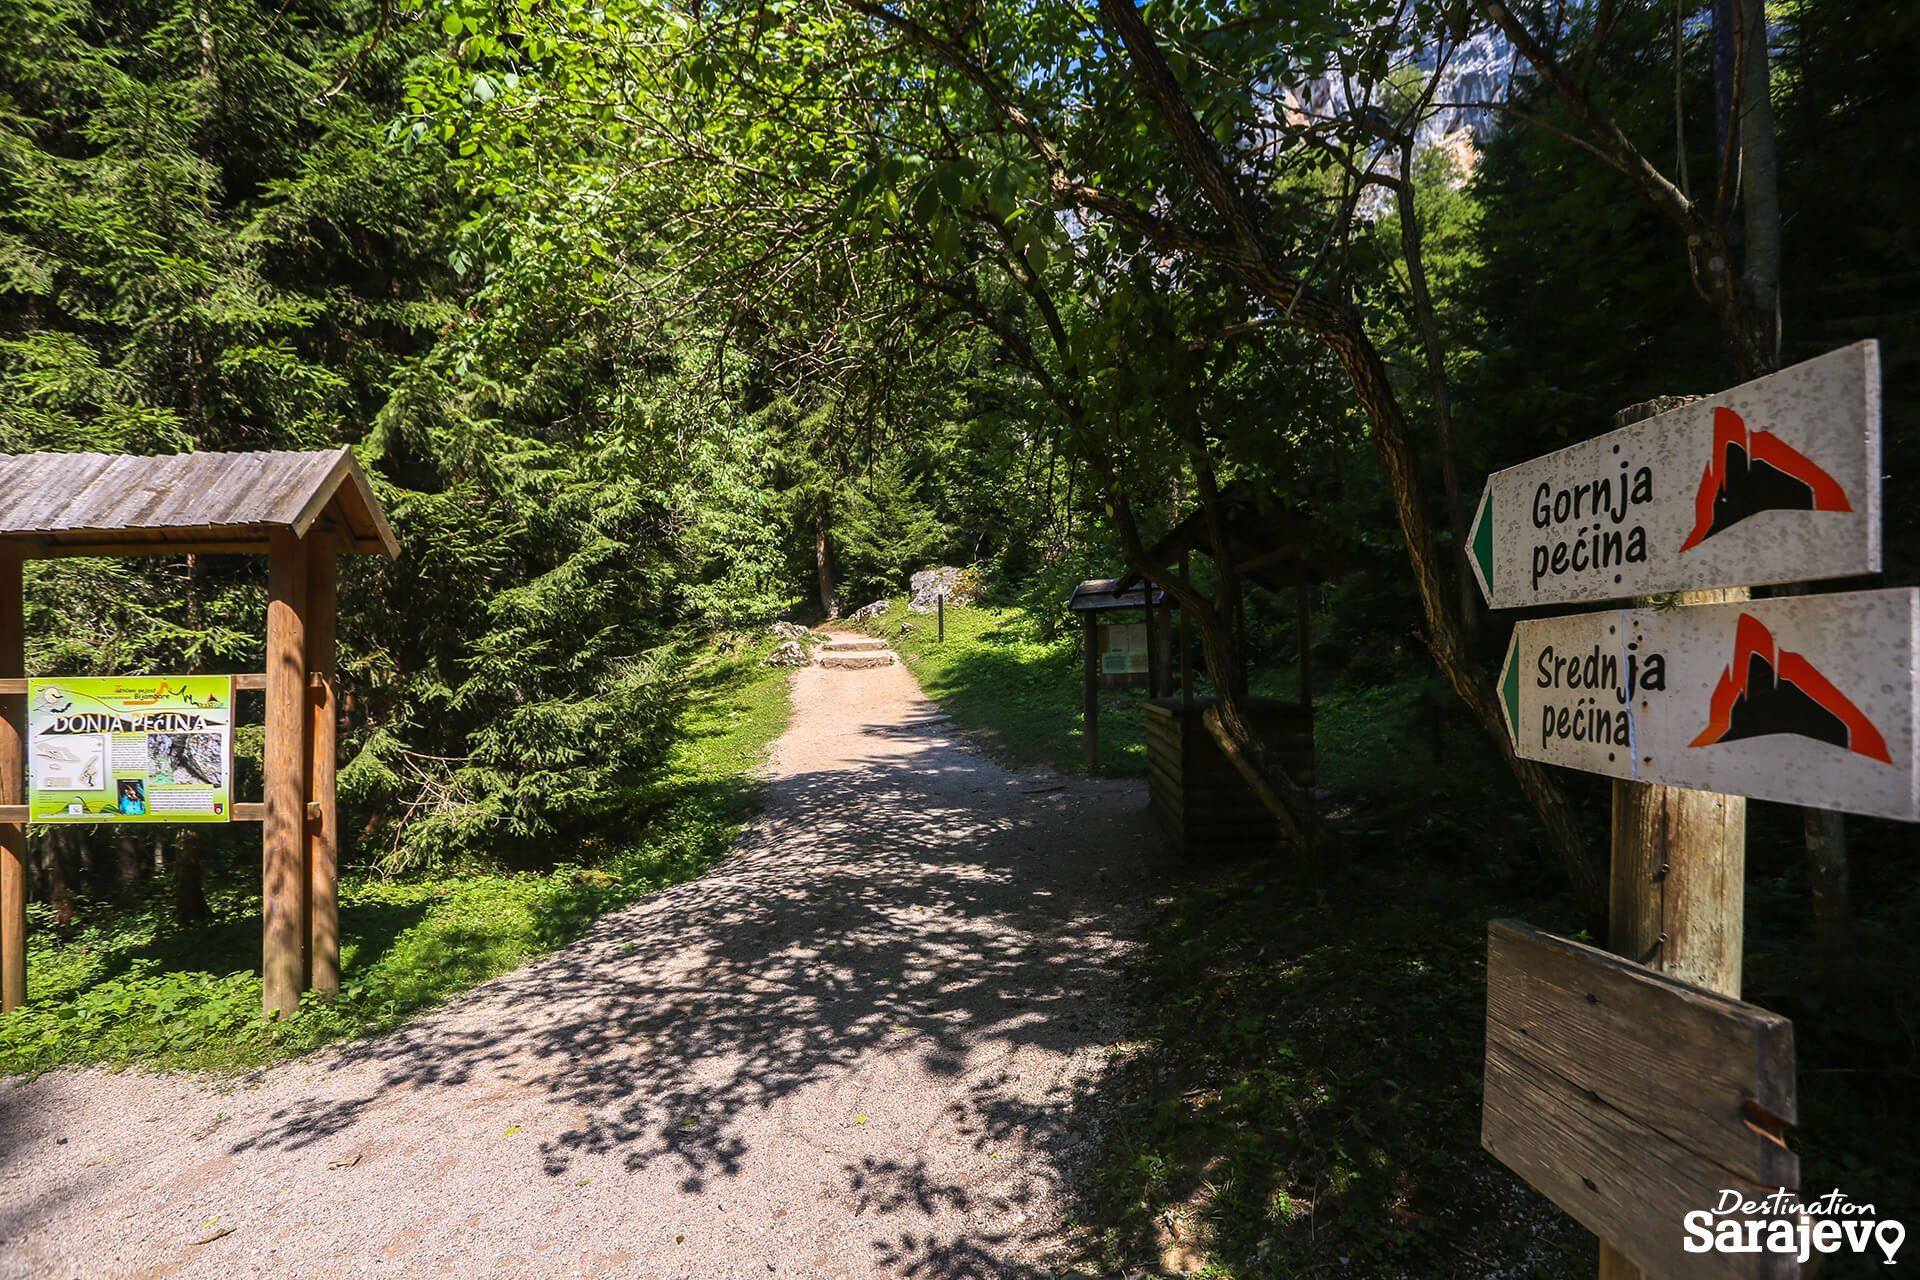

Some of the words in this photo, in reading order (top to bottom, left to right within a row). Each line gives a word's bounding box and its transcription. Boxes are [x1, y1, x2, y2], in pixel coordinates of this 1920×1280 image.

[1532, 460, 1653, 529] Gornja
[1532, 523, 1647, 591] pećina
[1536, 644, 1667, 704] Srednja
[53, 713, 123, 733] DONJA
[1541, 697, 1630, 749] pećina
